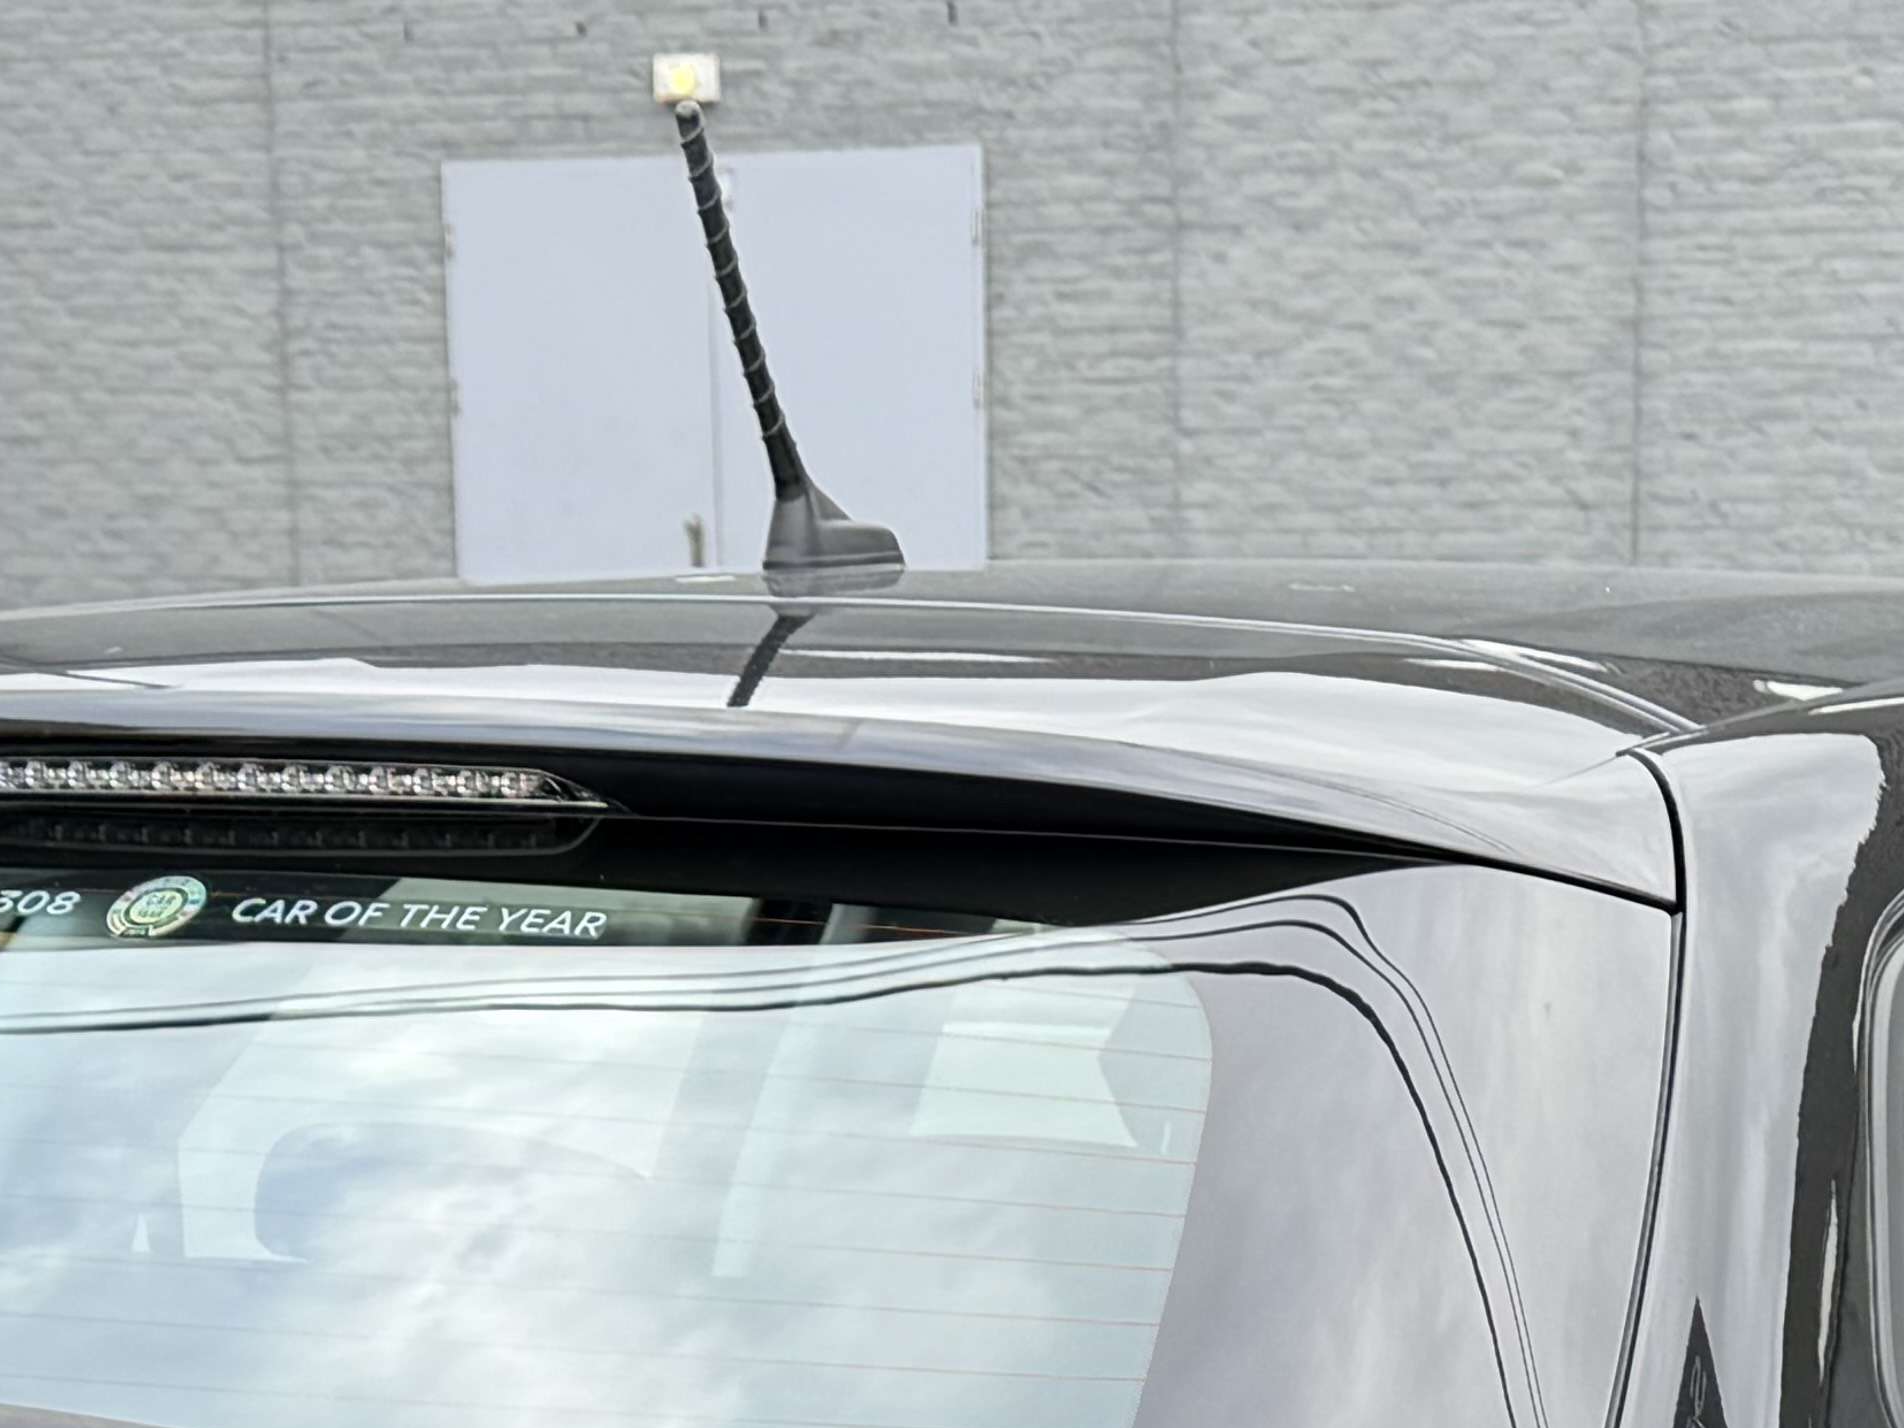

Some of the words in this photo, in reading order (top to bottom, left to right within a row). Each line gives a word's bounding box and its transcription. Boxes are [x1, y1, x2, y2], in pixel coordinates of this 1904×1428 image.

[231, 898, 319, 925] CAR
[324, 901, 391, 927] OF
[399, 903, 488, 931] THE
[498, 907, 608, 937] YEAR
